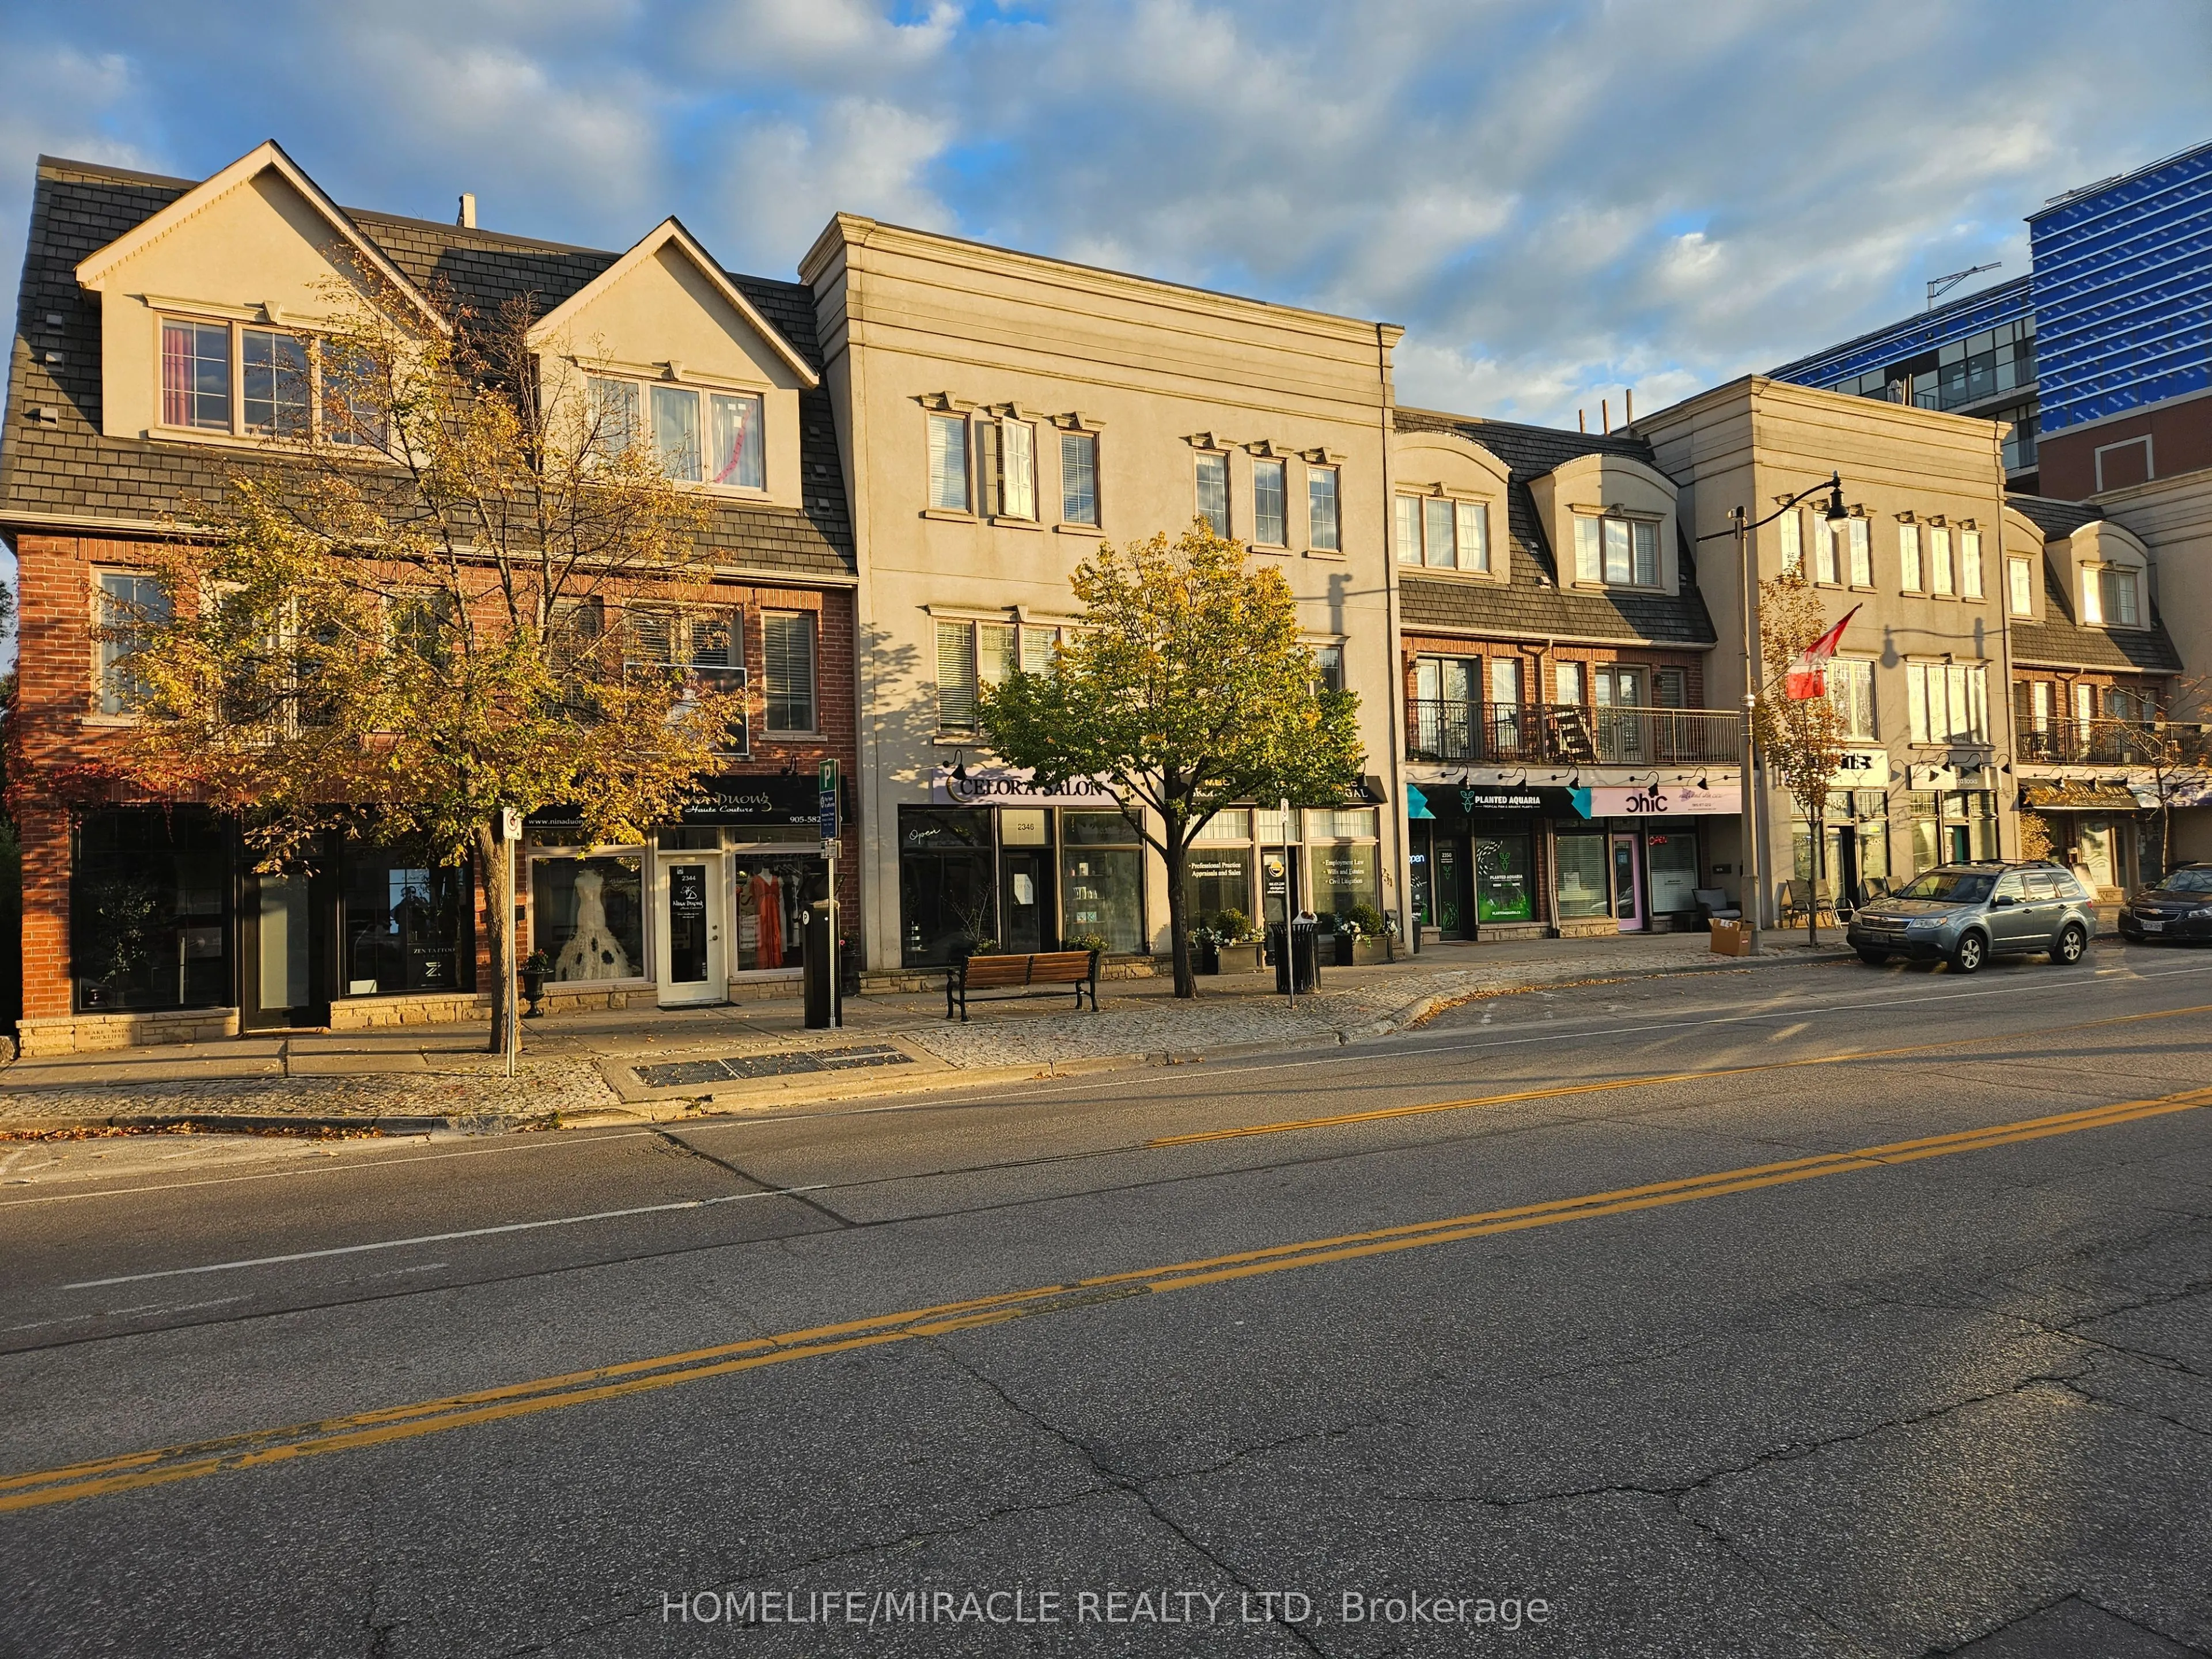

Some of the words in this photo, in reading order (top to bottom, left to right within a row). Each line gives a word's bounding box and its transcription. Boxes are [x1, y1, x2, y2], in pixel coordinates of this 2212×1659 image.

[824, 765, 831, 787] P
[960, 778, 1037, 796] CELORA
[1043, 781, 1102, 797] SALON
[1344, 789, 1368, 798] GAL
[1509, 796, 1540, 805] AQUARIA
[909, 829, 941, 844] Open
[1649, 835, 1668, 845] OPEN
